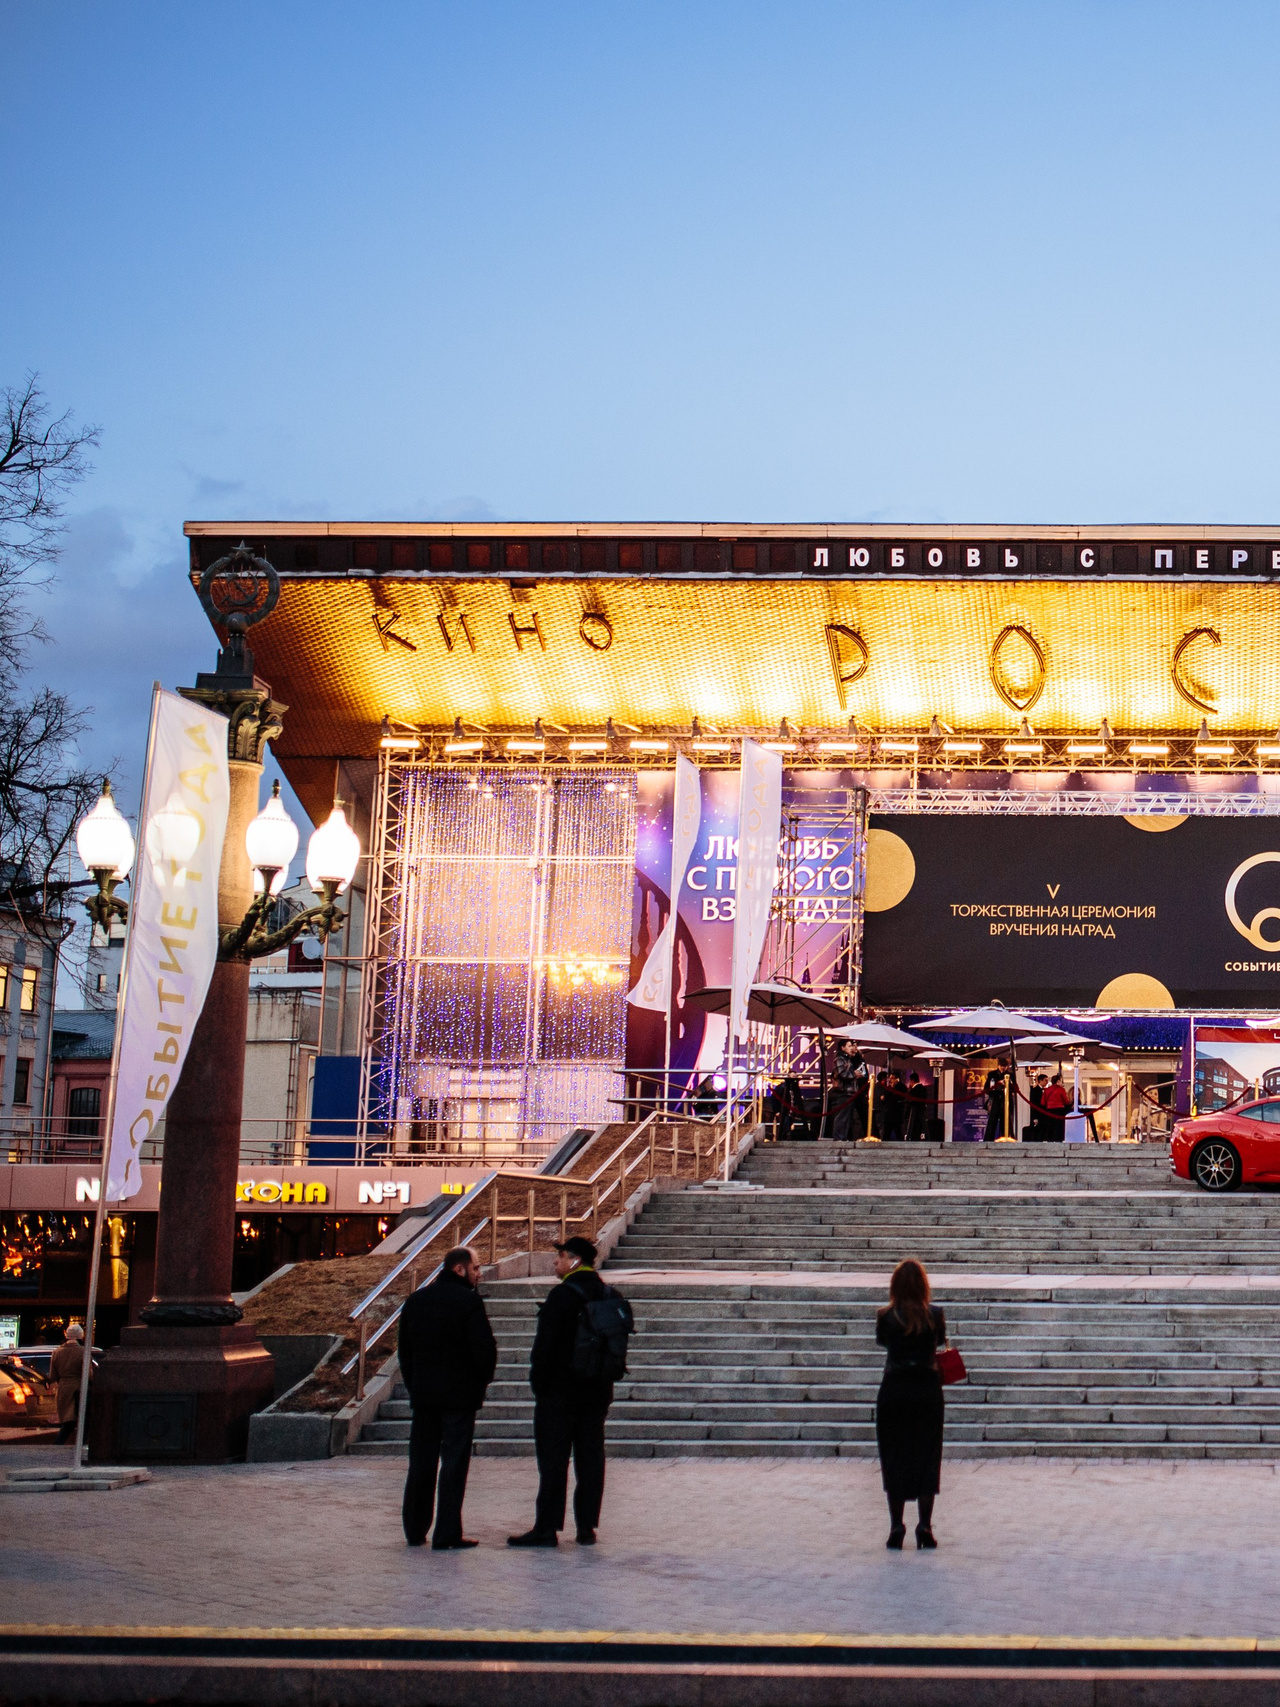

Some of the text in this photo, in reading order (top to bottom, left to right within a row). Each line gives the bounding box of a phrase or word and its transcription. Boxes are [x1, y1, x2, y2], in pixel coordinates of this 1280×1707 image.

[813, 548, 1018, 568] ЛЮБОВЬ
[1080, 549, 1095, 568] С
[371, 611, 613, 652] КИНО
[703, 835, 841, 861] ЛОВЬ
[687, 866, 707, 891] С
[950, 905, 1156, 920] ТОРЖЕСТВЕННАЯ ЦЕРЕМОНИЯ
[989, 924, 1116, 939] ВРУЧЕНИЯ НАГРАД
